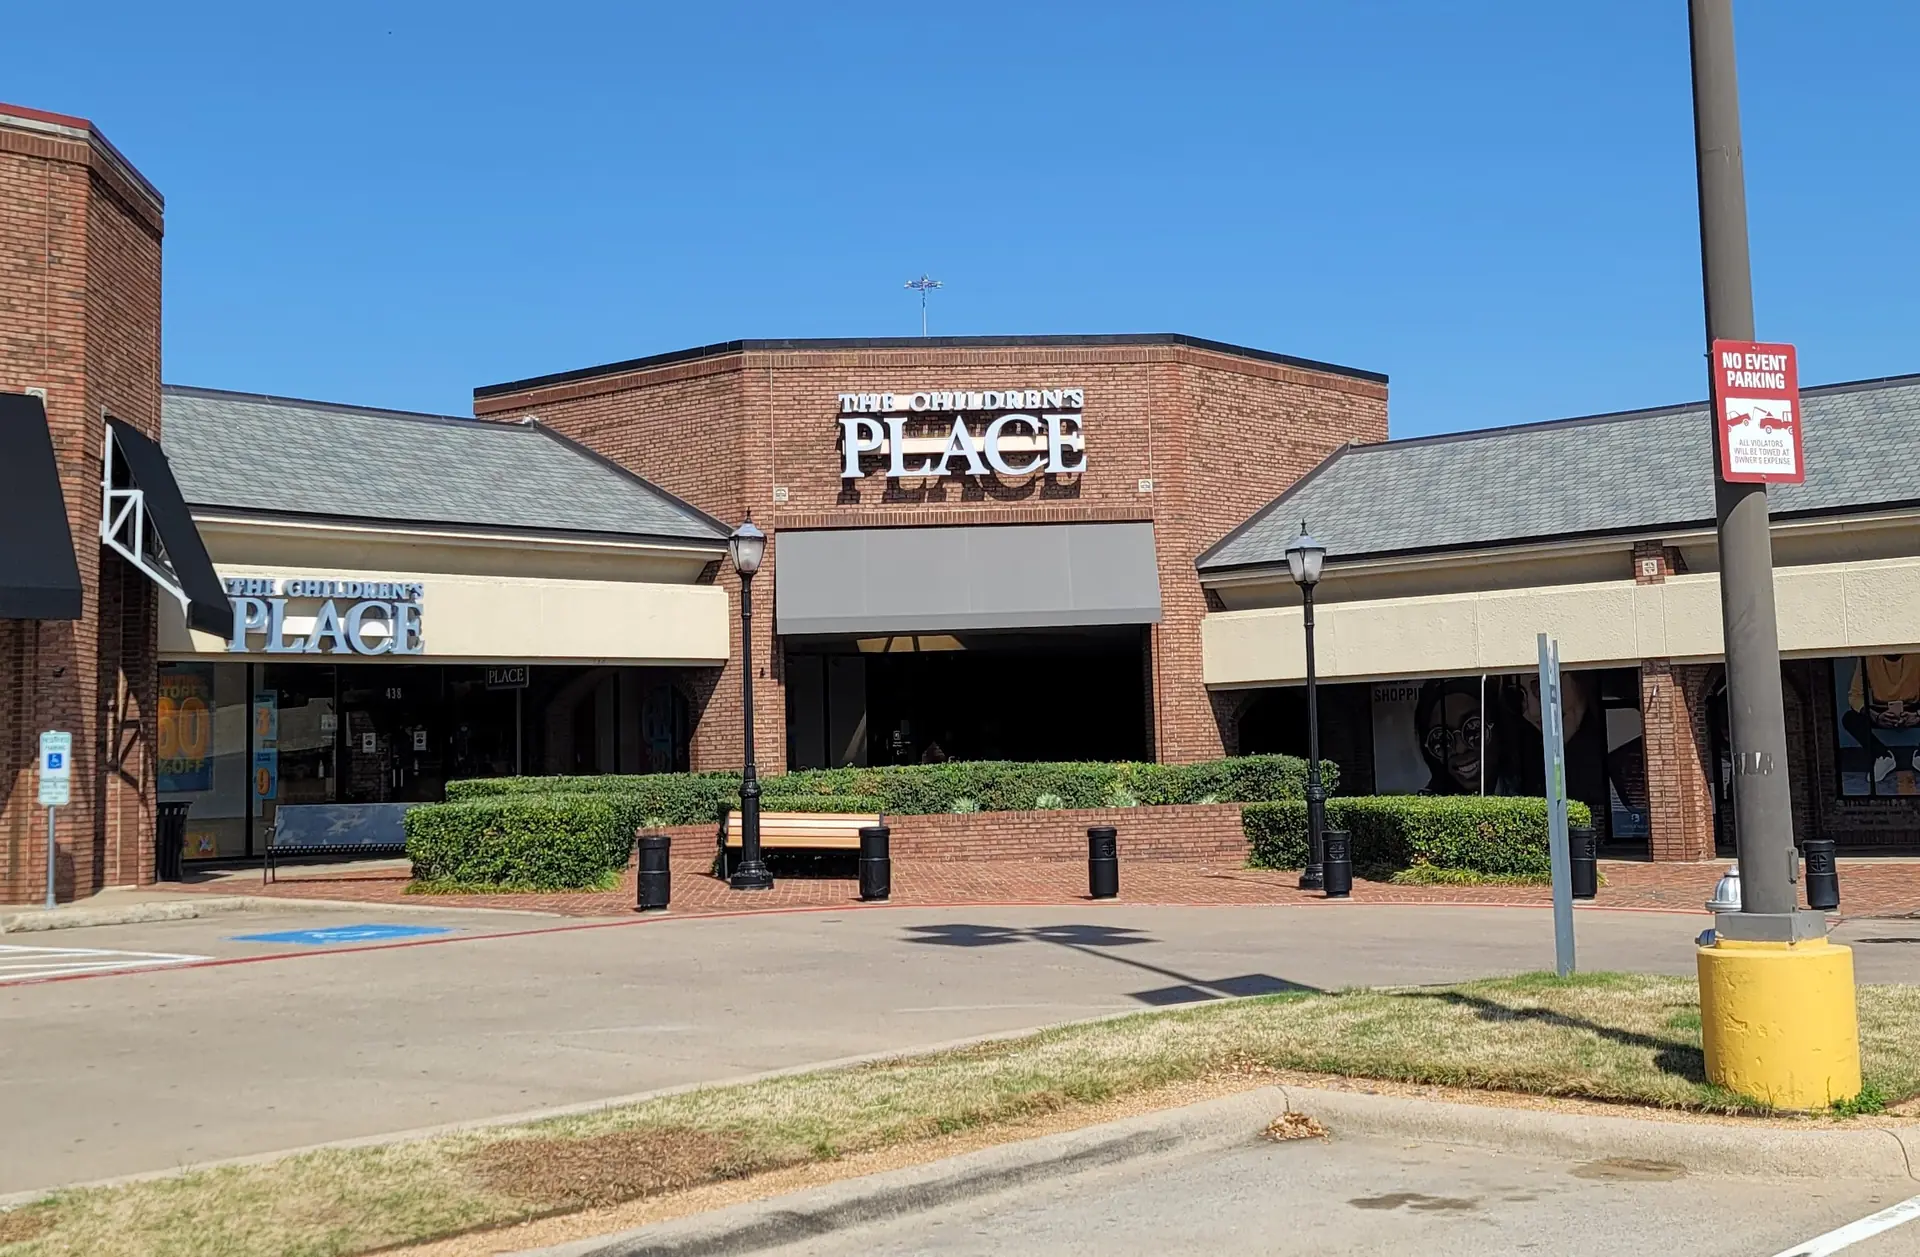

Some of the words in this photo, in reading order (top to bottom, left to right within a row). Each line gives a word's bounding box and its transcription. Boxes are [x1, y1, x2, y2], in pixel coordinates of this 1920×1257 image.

[1722, 352, 1742, 369] NO
[1745, 353, 1787, 371] EVENT
[1726, 370, 1785, 389] PARKING
[838, 392, 894, 413] THE
[909, 388, 1084, 412] CHILDREN'S
[838, 413, 1087, 478] PLACE
[1734, 447, 1748, 456] WILL
[1750, 448, 1757, 456] BE
[1759, 448, 1781, 456] TOWED
[1738, 439, 1749, 447] ALL
[1751, 439, 1784, 447] VIOLATORS
[1764, 457, 1791, 465] EXPENSE
[225, 578, 275, 596] THE
[282, 580, 424, 600] CHILDREN'S
[225, 597, 425, 655] PLACE
[488, 667, 524, 684] PLACE
[385, 687, 402, 699] 438
[1374, 687, 1418, 701] SHOPPI
